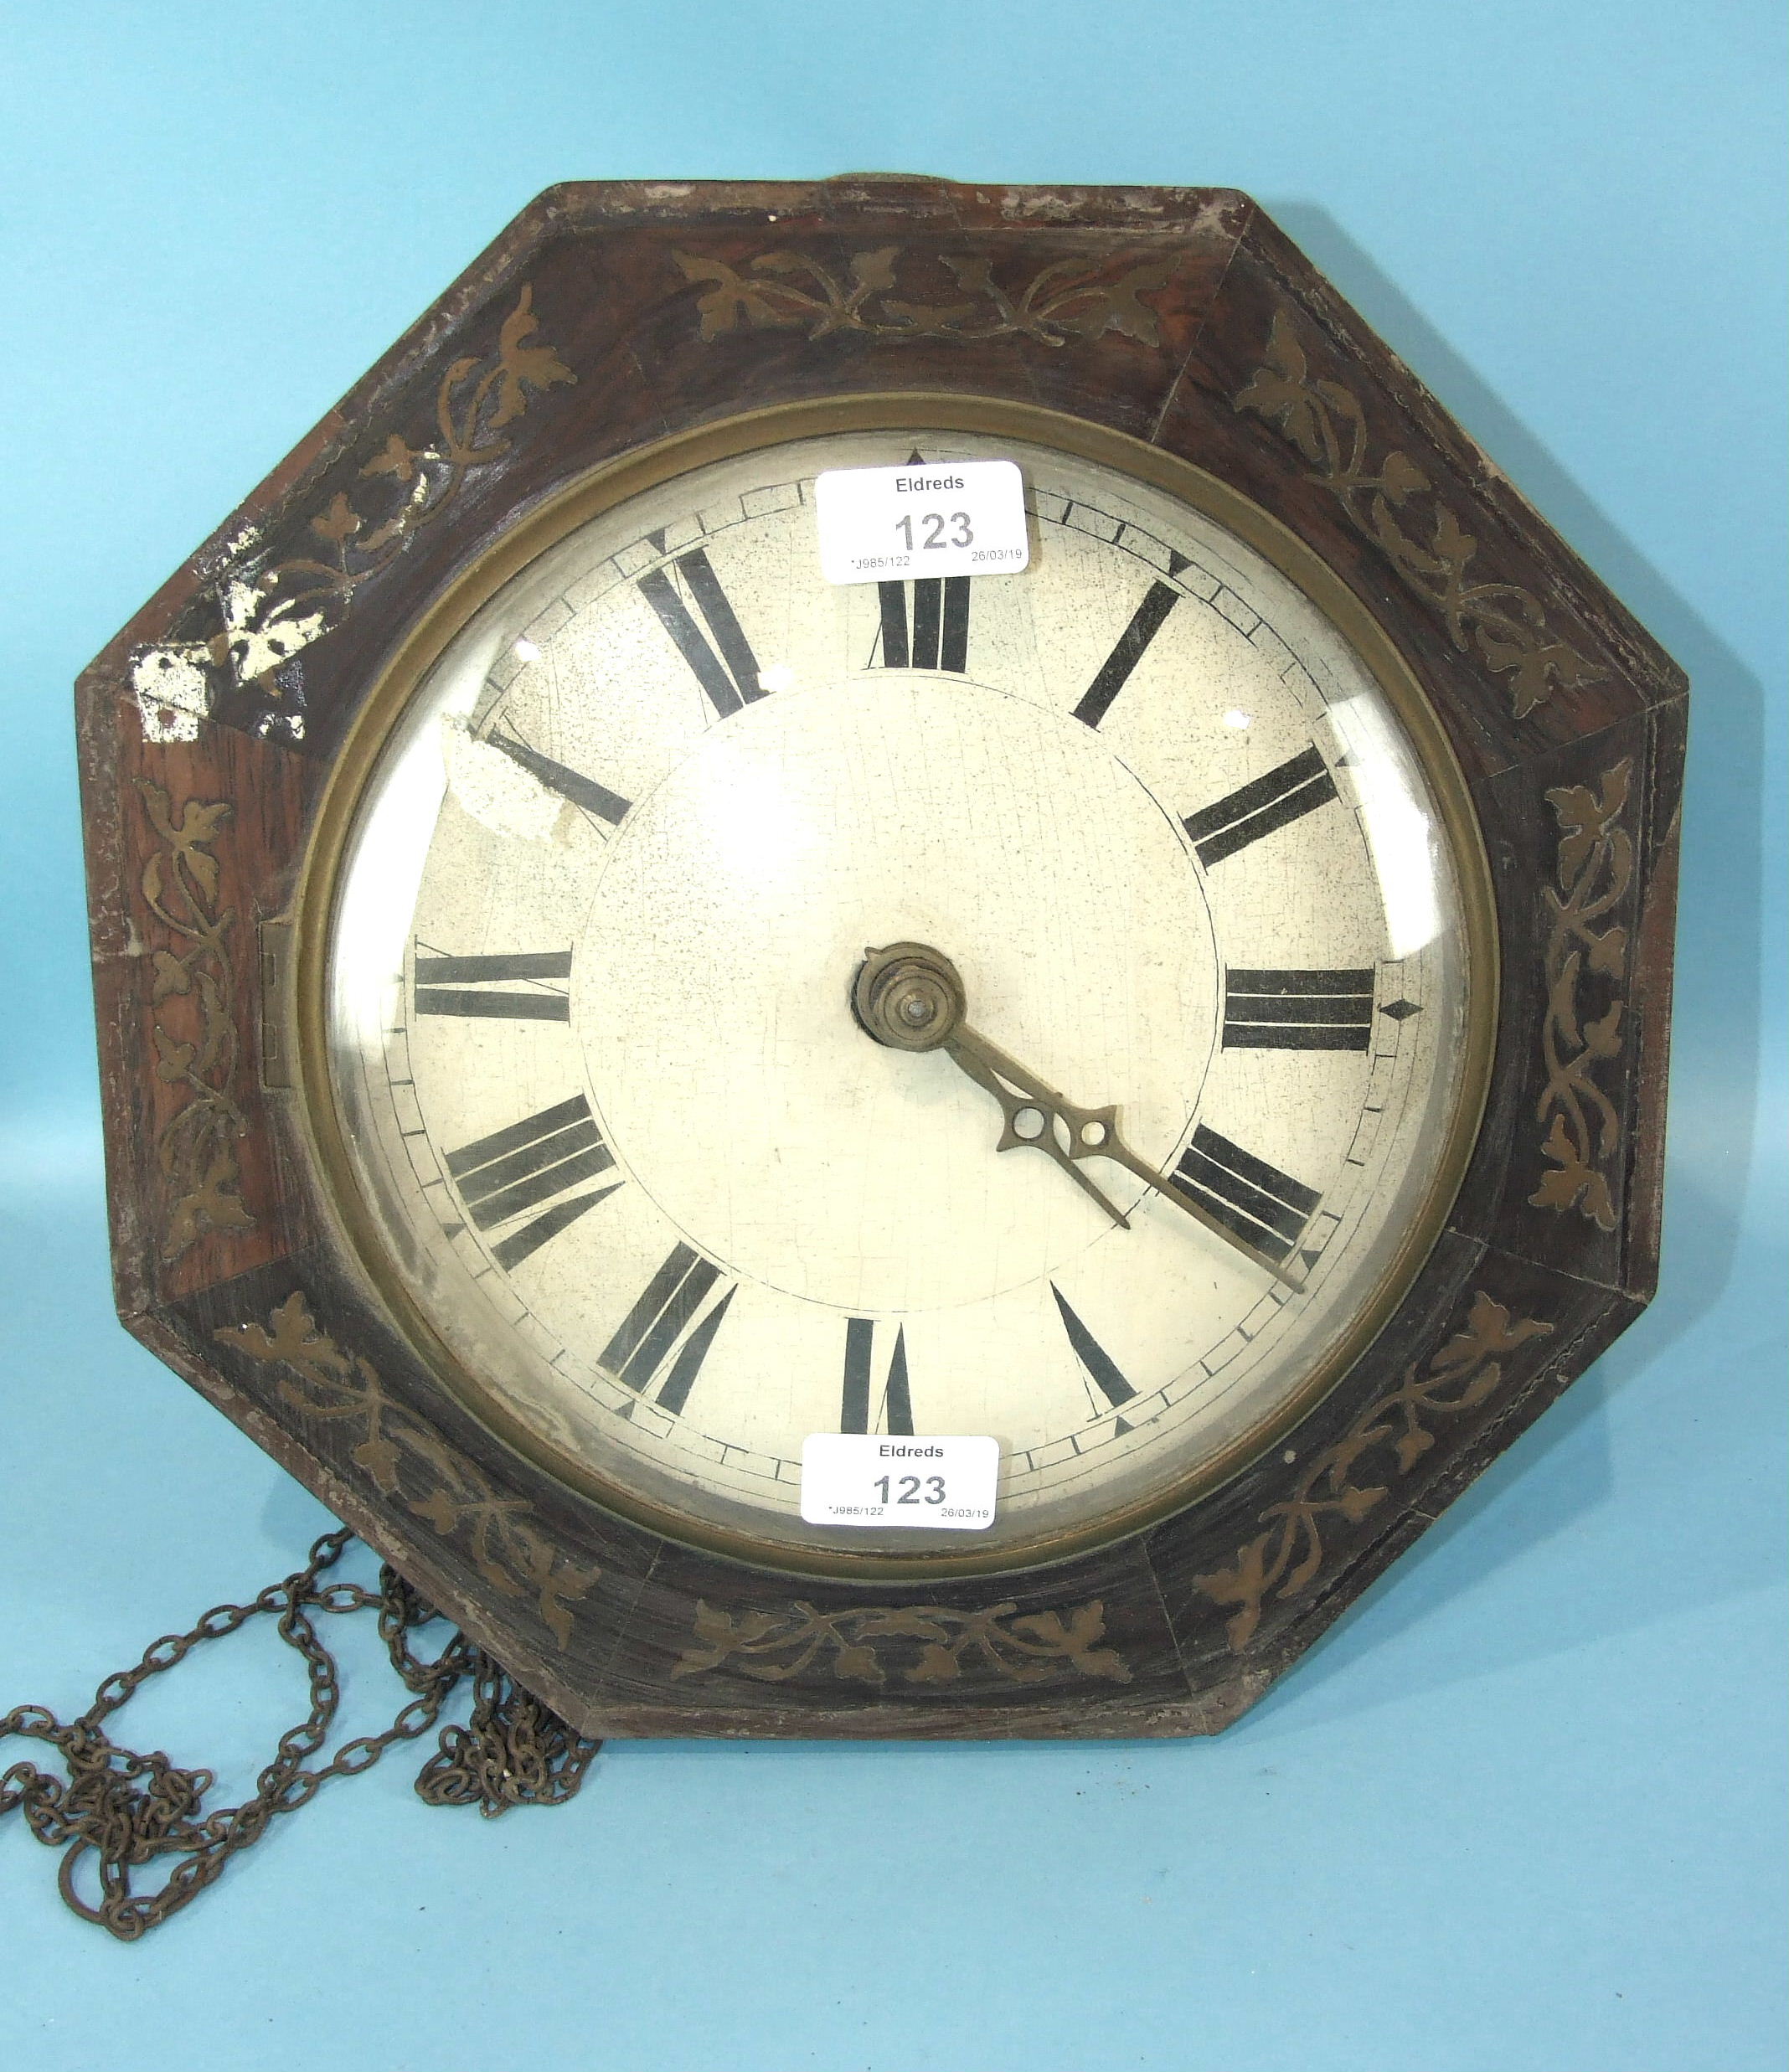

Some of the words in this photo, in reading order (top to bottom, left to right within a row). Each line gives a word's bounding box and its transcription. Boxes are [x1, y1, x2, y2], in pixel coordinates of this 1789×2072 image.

[895, 476, 965, 492] Eldreds
[895, 512, 974, 550] 123
[971, 549, 1023, 562] 26/03/19
[634, 544, 777, 734] XI
[1070, 577, 1184, 732] I
[1178, 741, 1342, 875] II
[413, 934, 573, 1028] IX
[1222, 962, 1375, 1054] III
[440, 1092, 626, 1277] VIII
[595, 1240, 739, 1417] VII
[1049, 1279, 1142, 1422] V
[874, 1475, 946, 1505] 123
[879, 1445, 945, 1458] Eldreds
[941, 1508, 989, 1518] 26/03/19
